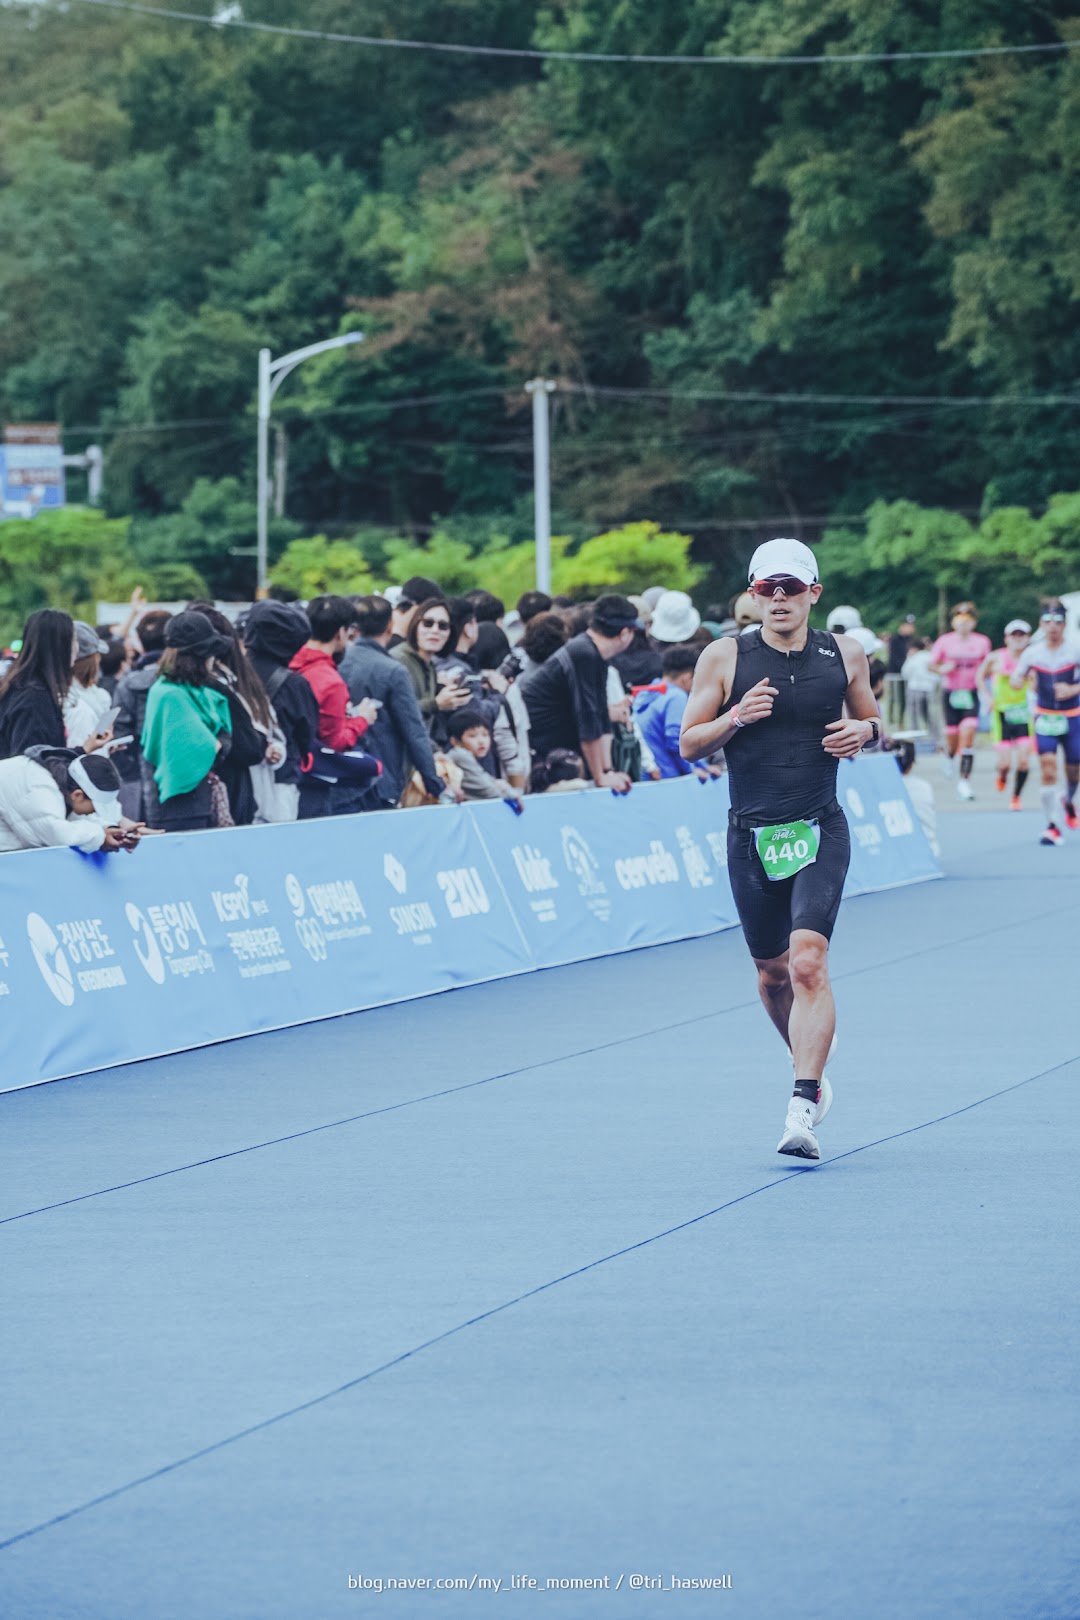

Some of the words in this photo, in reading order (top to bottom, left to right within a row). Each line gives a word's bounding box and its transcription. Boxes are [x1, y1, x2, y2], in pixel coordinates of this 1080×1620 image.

[764, 839, 809, 865] 440
[436, 867, 491, 919] 2XU
[56, 918, 116, 965] 경상남도
[147, 901, 207, 954] 통영시
